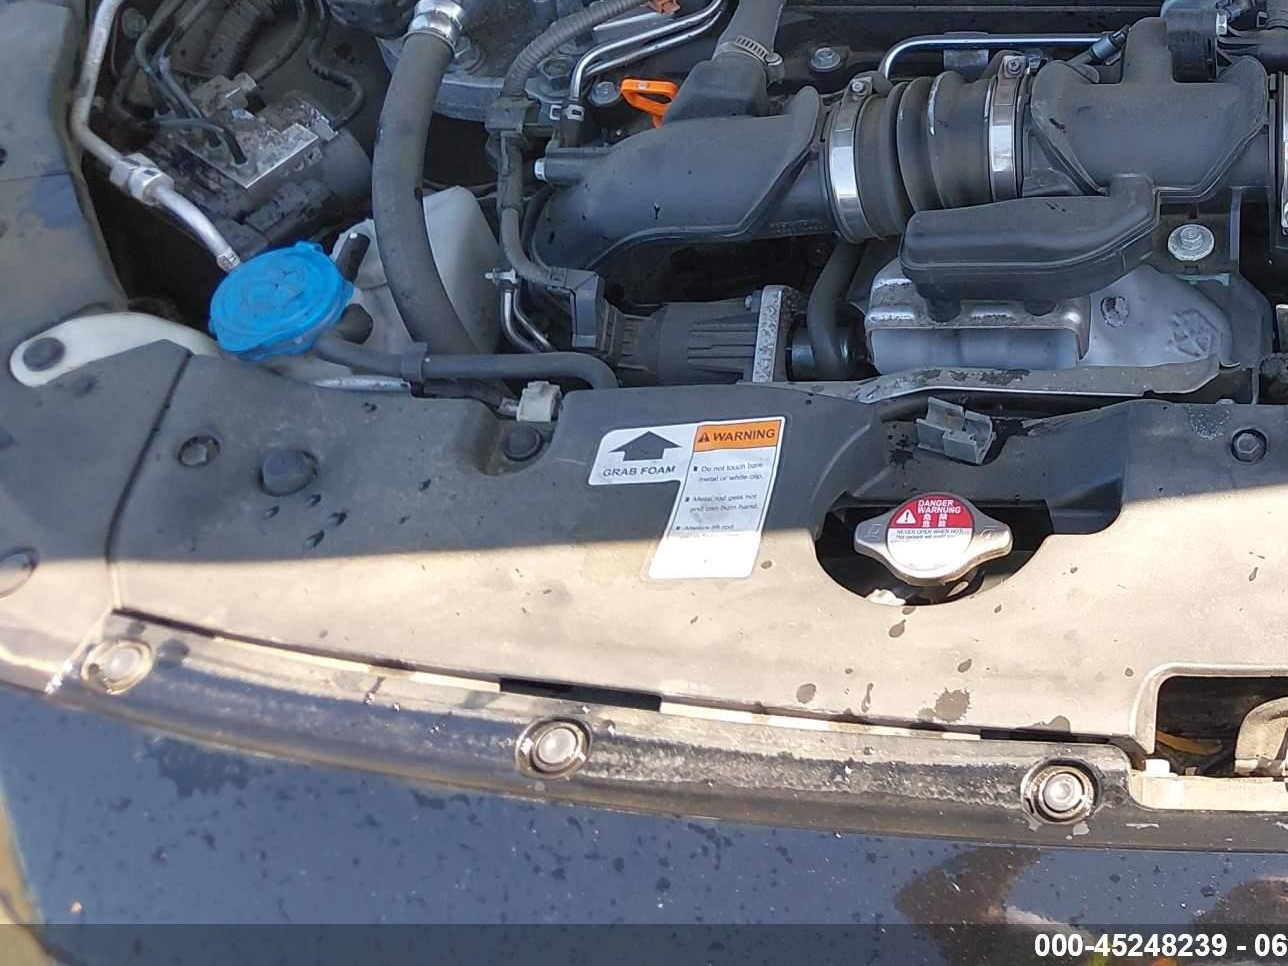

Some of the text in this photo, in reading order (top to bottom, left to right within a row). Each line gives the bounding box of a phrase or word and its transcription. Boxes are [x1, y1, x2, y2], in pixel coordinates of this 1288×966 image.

[713, 428, 776, 442] WARNING
[603, 465, 676, 477] GRAB FOAM
[726, 463, 746, 471] touch
[917, 506, 961, 514] WARNUNG
